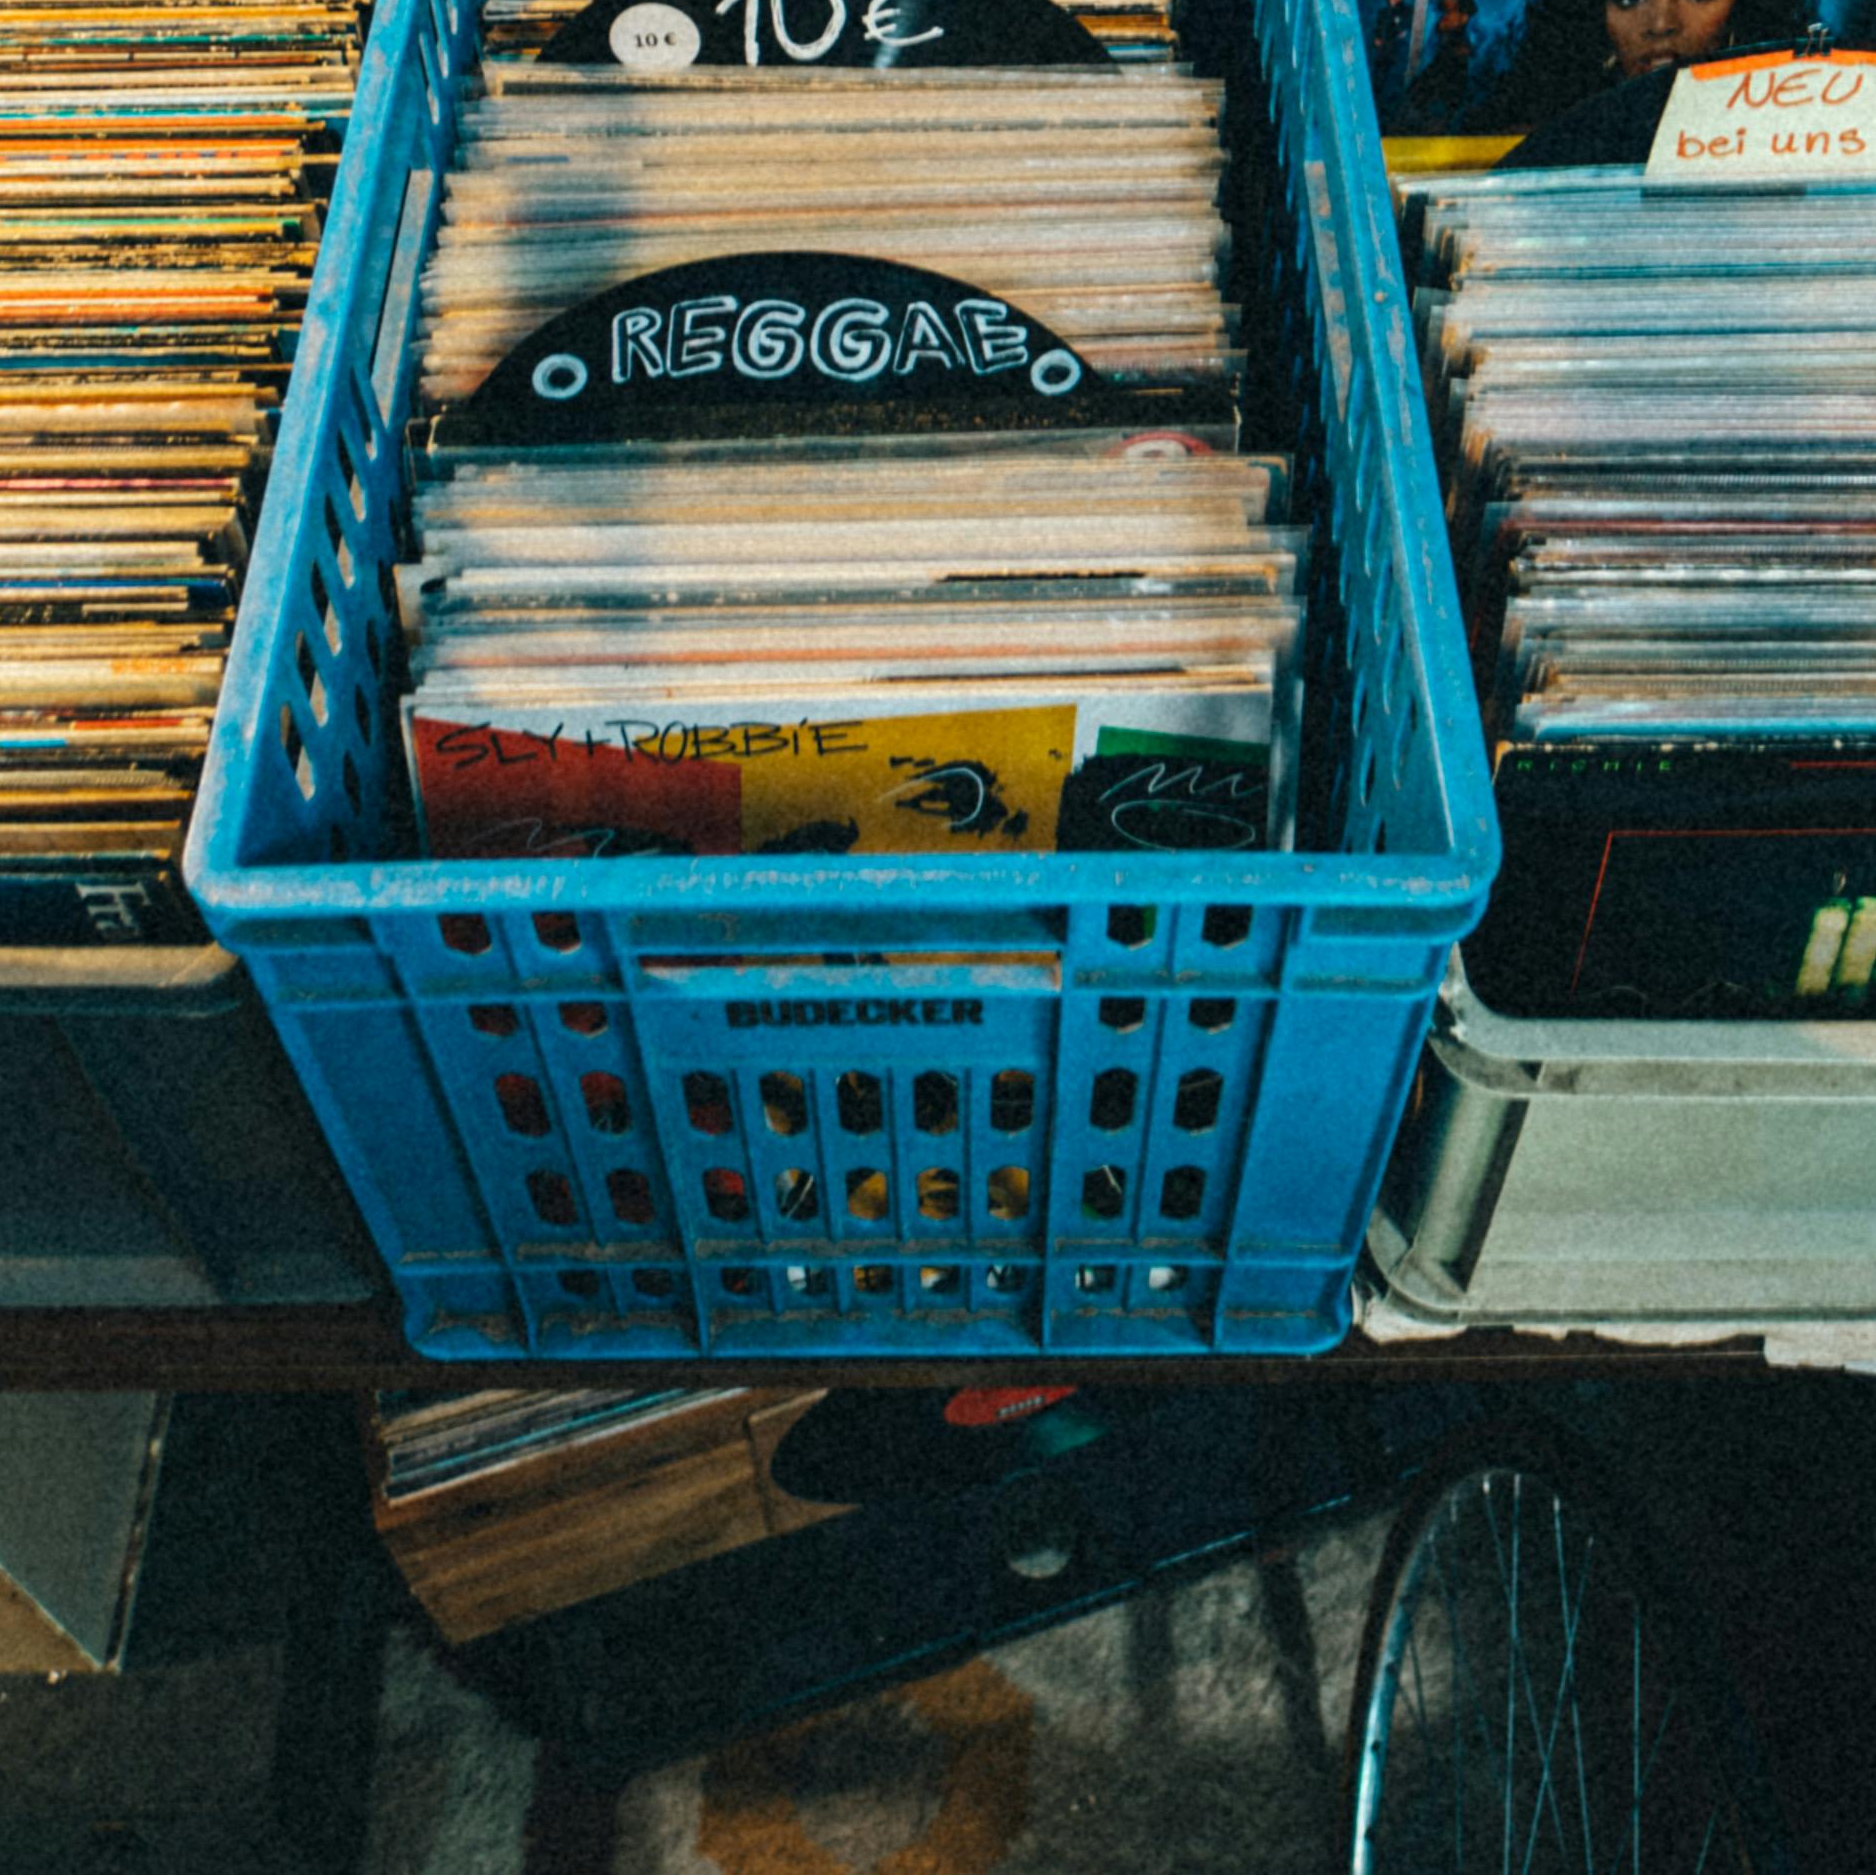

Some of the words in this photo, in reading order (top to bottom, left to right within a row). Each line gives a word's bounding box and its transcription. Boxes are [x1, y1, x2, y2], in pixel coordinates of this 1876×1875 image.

[634, 33, 660, 49] 10
[1726, 68, 1865, 110] NEU
[1676, 127, 1747, 160] bei
[1771, 127, 1867, 156] uns
[611, 295, 1029, 385] REGGAE
